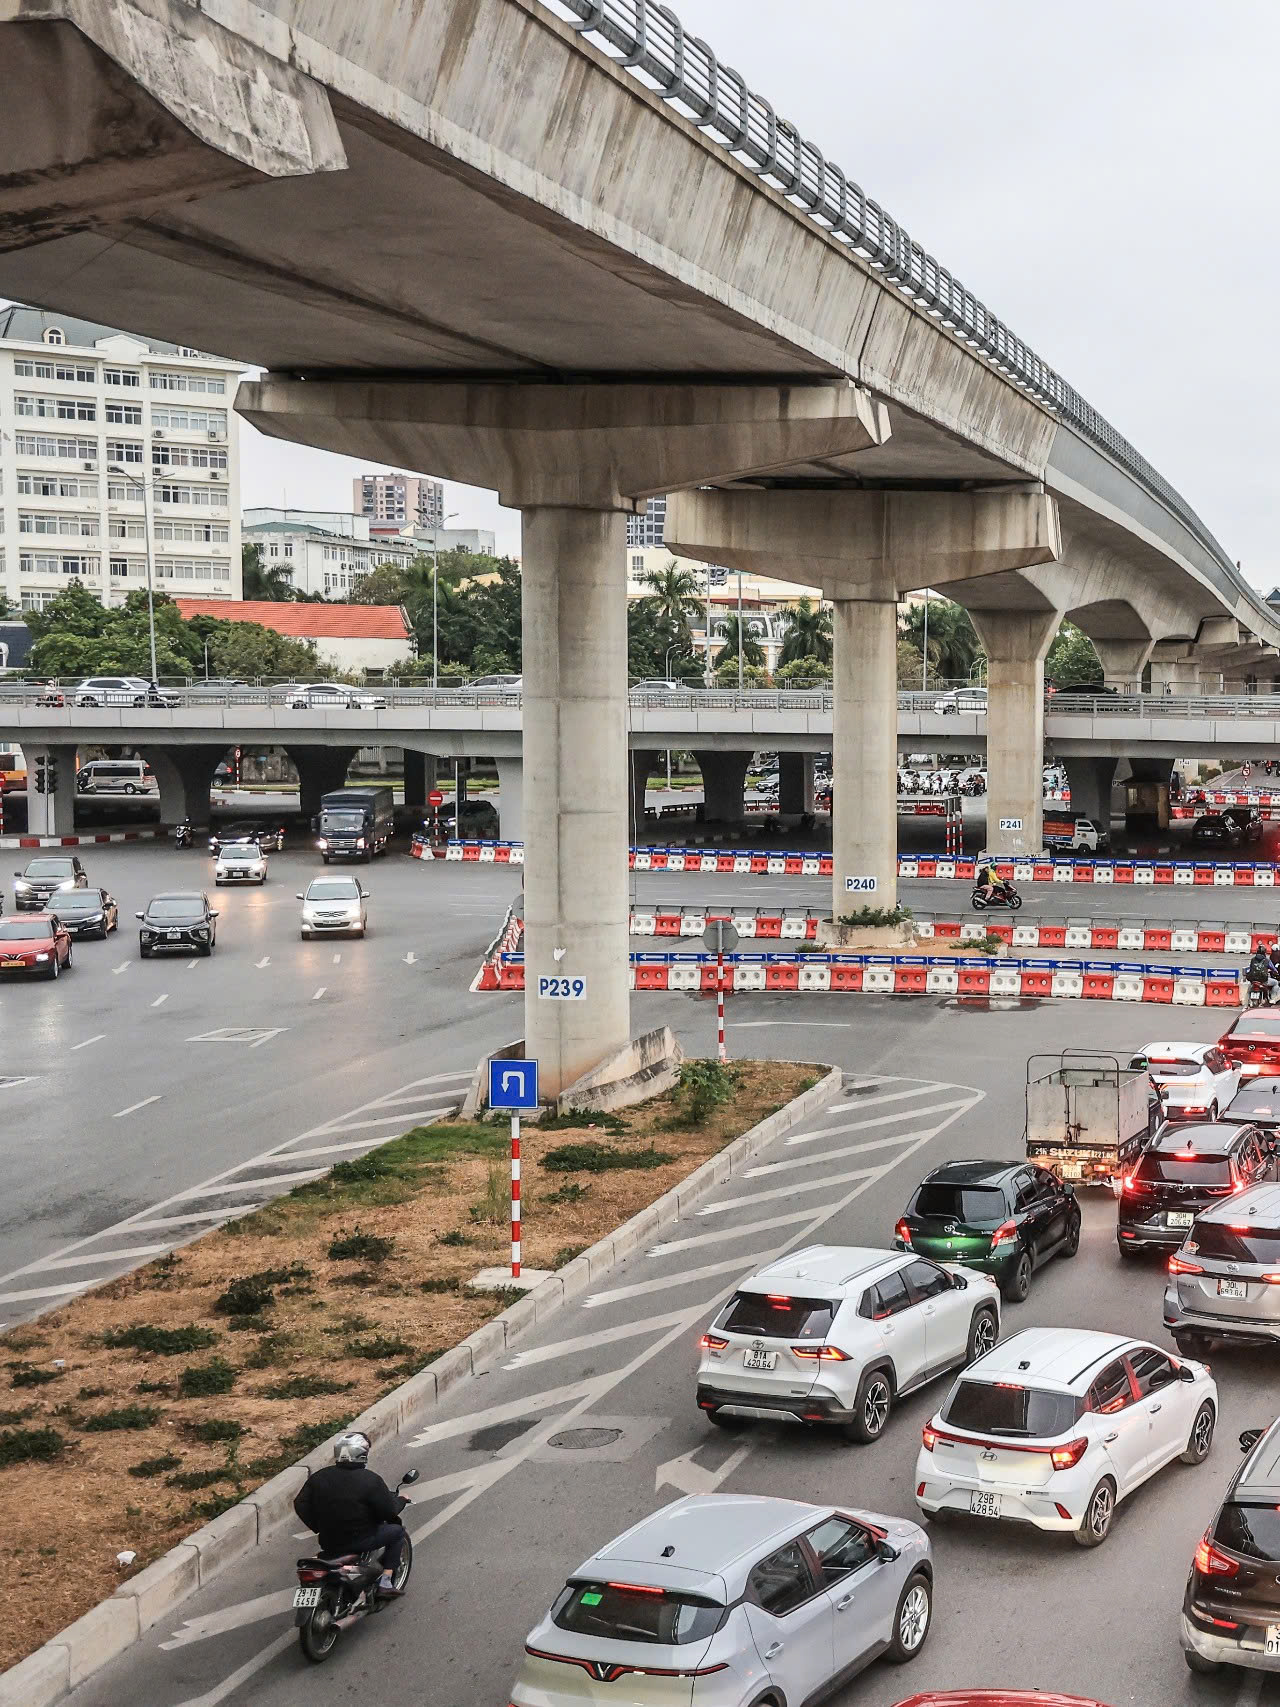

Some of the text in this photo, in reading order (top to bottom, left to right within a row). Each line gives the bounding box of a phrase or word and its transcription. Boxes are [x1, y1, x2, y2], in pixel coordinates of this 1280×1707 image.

[1001, 820, 1021, 828] P241
[847, 878, 875, 890] P240
[540, 978, 584, 997] P239
[978, 1492, 994, 1505] 29B
